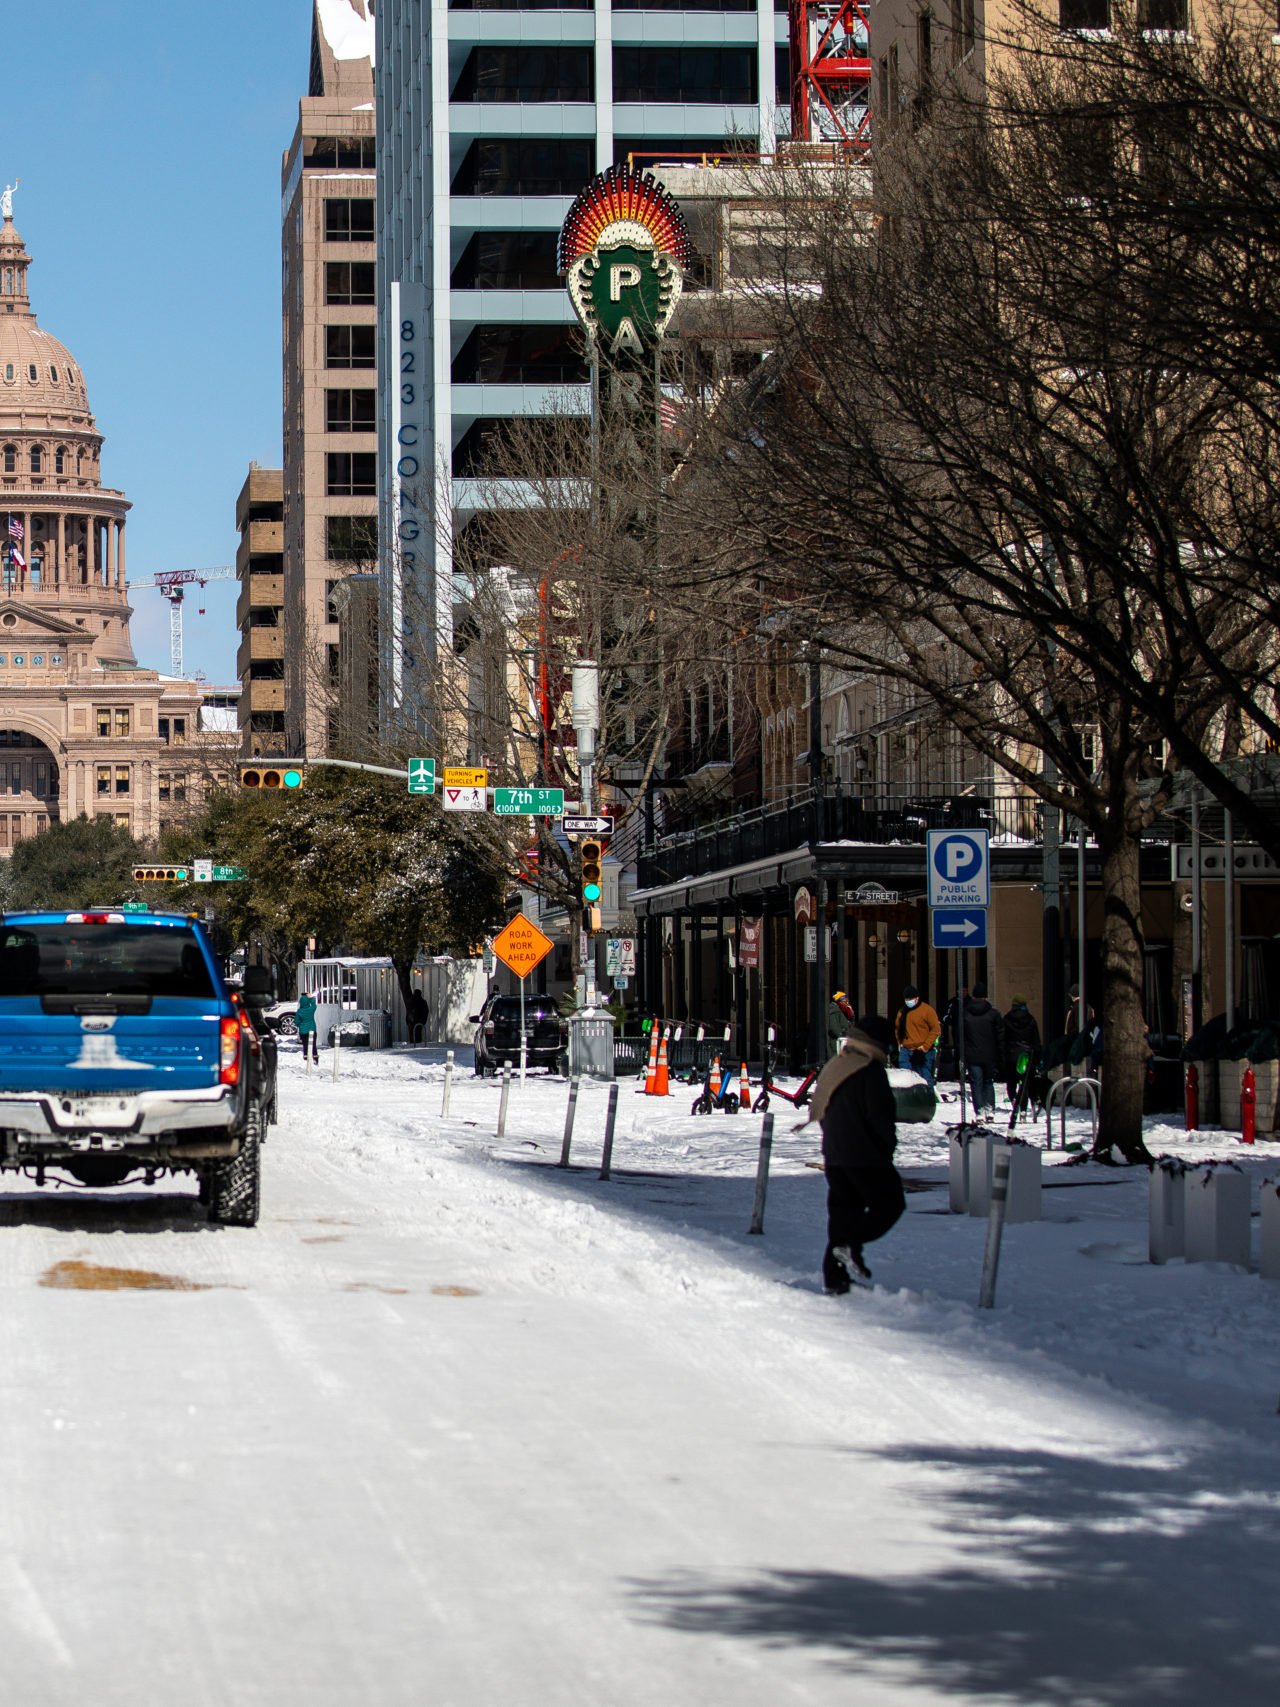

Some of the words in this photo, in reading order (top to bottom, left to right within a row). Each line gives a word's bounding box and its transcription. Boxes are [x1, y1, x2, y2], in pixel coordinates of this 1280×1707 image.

[401, 320, 415, 404] 823
[398, 424, 419, 668] CONGRSS
[447, 777, 473, 785] VEHICLES
[508, 790, 533, 804] 7th
[538, 791, 550, 799] ST
[501, 805, 520, 813] 100W
[538, 805, 556, 813] 100E
[946, 842, 974, 877] P
[220, 867, 233, 875] 8th
[940, 885, 976, 893] PUBLIC
[866, 892, 895, 900] STREET
[936, 895, 981, 903] PARKING
[509, 930, 533, 938] ROAD
